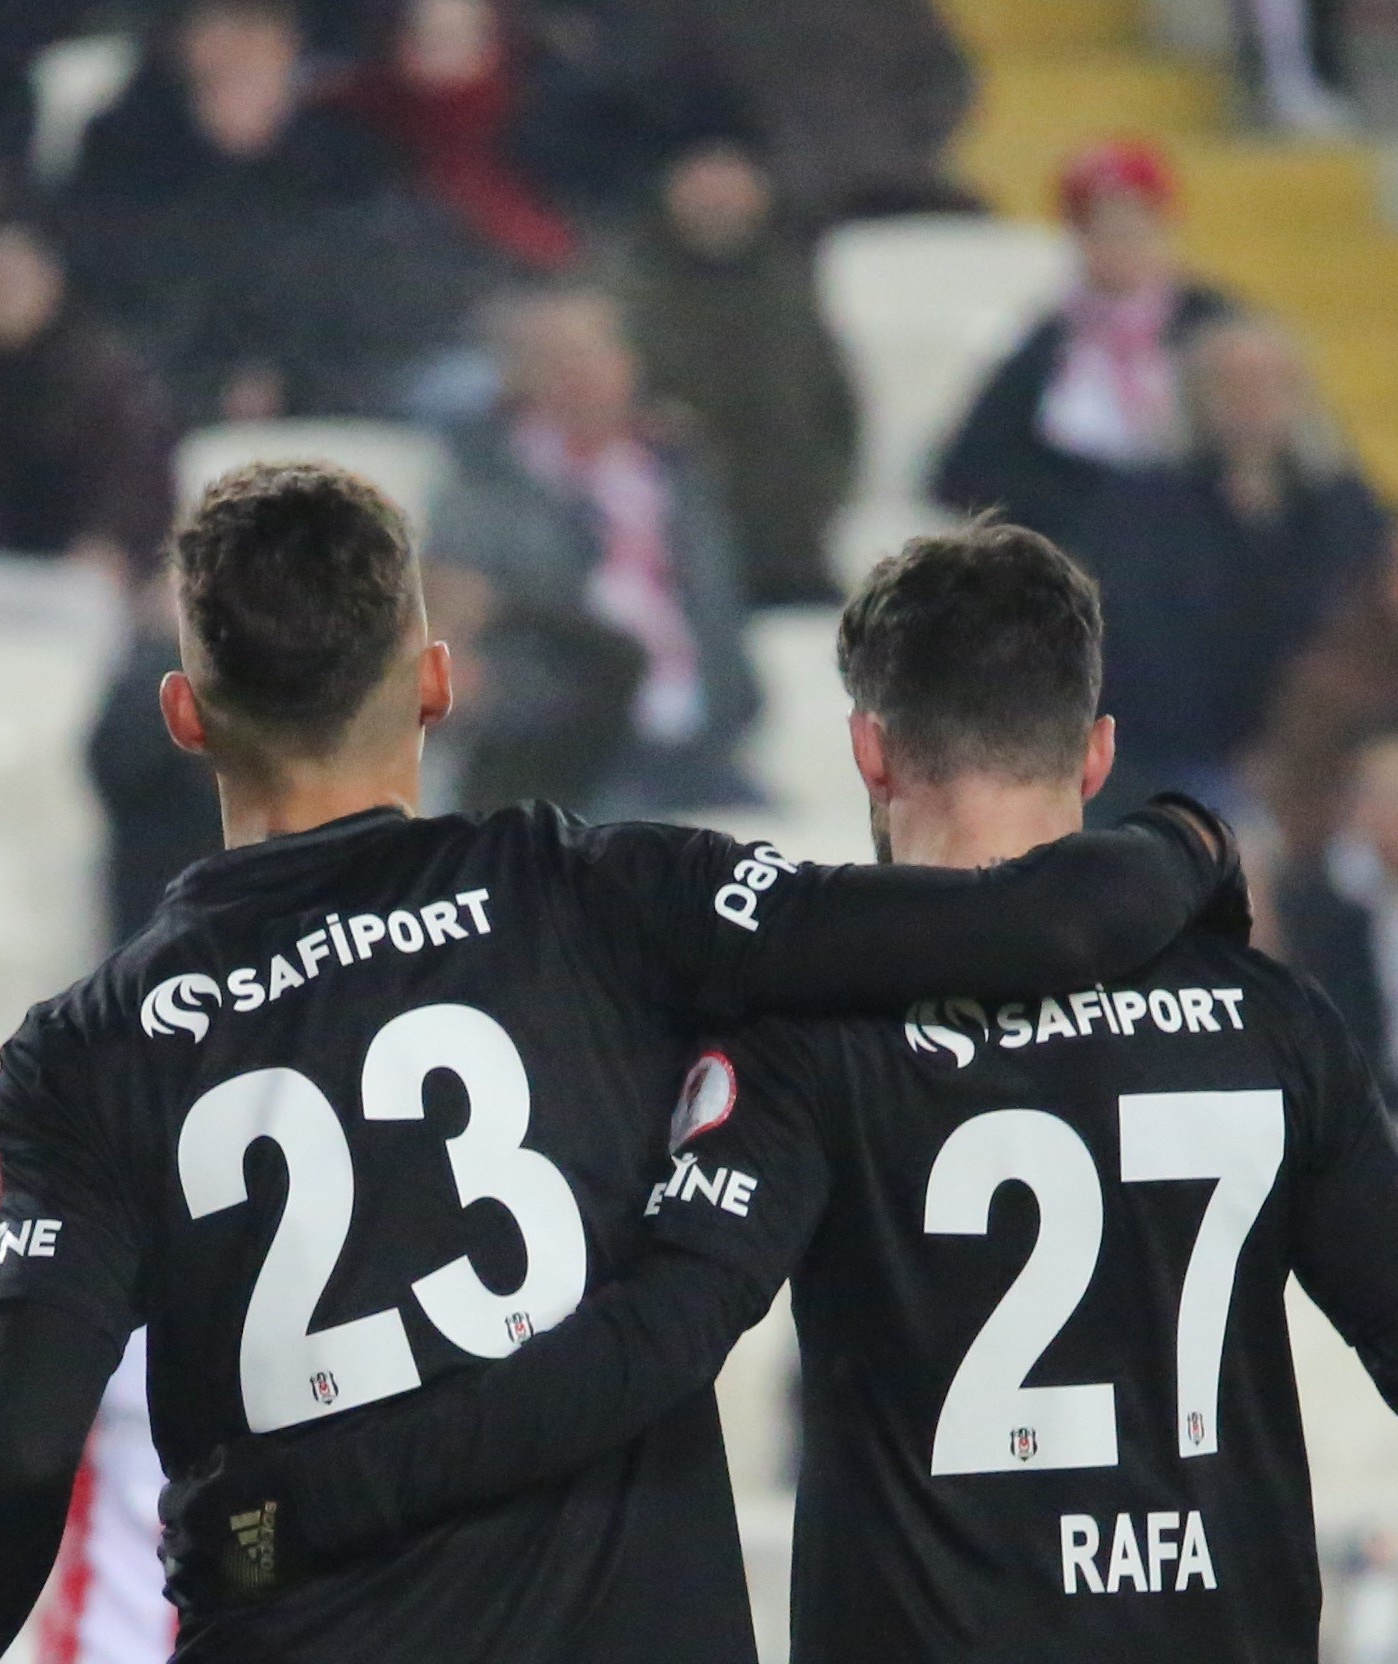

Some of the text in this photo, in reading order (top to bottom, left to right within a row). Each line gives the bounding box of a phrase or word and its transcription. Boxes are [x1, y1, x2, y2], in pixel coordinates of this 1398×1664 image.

[227, 888, 491, 1012] SAFİPORT
[998, 983, 1244, 1049] SAFİPORT
[177, 1004, 586, 1433] 23
[923, 1089, 1286, 1477] 27
[1060, 1511, 1218, 1595] RAFA
